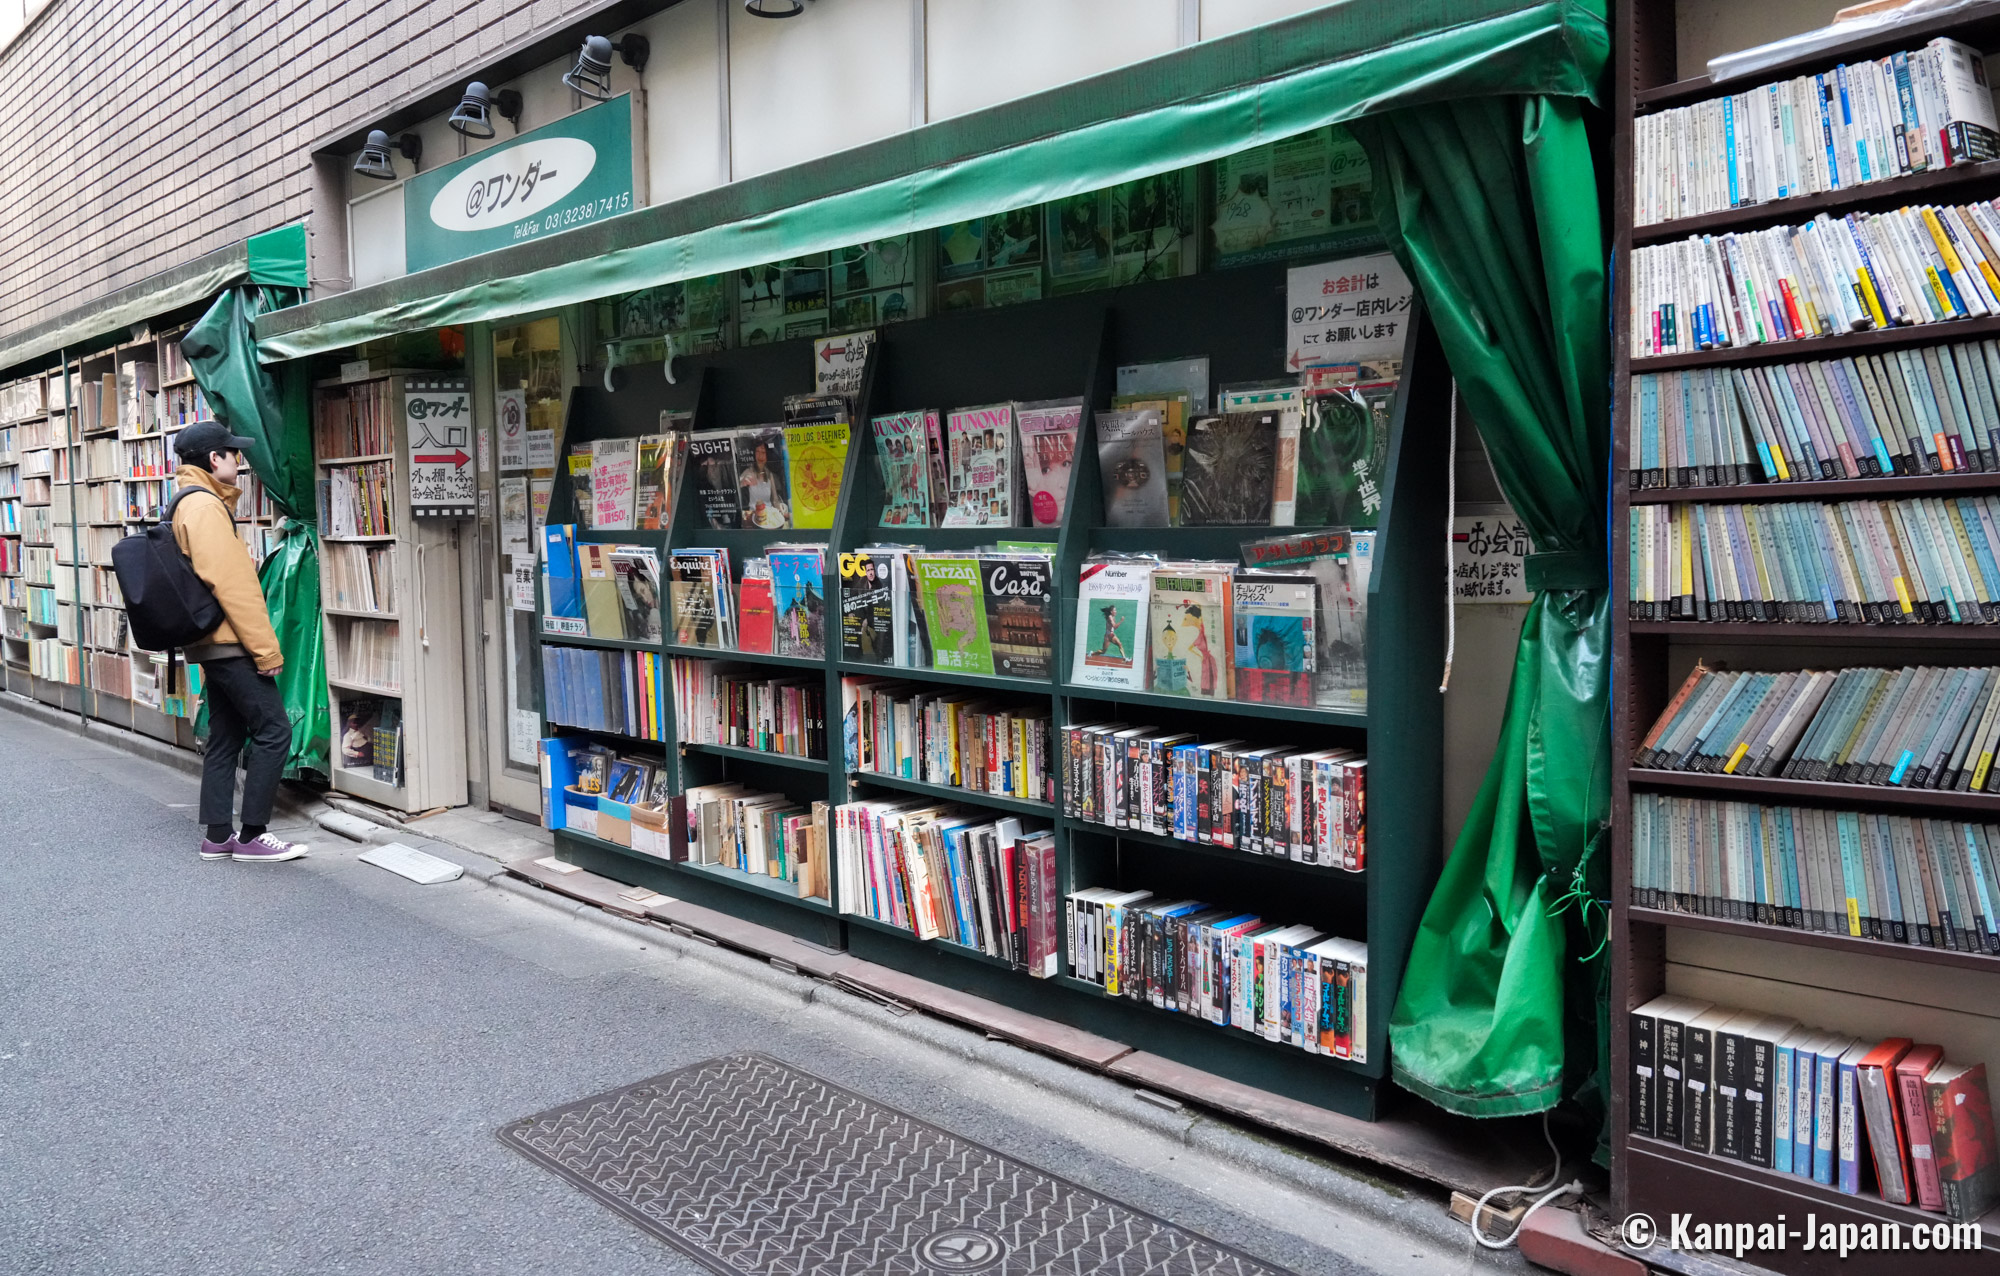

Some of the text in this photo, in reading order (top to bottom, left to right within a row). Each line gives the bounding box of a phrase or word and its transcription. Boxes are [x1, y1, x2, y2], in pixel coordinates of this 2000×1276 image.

[465, 160, 557, 218] @ワンダー
[513, 192, 629, 239] Tel&Fax 03(3238)7415
[1322, 273, 1379, 294] お会計は
[1292, 295, 1413, 323] @ワンダー店内レジ
[1303, 322, 1398, 345] にて お願いします
[407, 396, 469, 420] @ワンダー
[411, 423, 467, 449] 入口
[690, 440, 730, 455] SIGHT
[787, 433, 801, 443] TRIO
[817, 429, 846, 440] DELFINES
[411, 468, 474, 483] 外の棚の本の
[1352, 458, 1382, 516] 地下世界
[411, 484, 474, 500] お会計はこちら
[1252, 536, 1344, 560] アサヒグラフ
[670, 557, 712, 574] Esquire
[921, 564, 977, 580] Tarzan
[990, 566, 1043, 596] Casa
[1235, 584, 1274, 594] チェルノブイリ
[1235, 593, 1266, 602] クライシス
[560, 621, 584, 632] 映画チラシ
[1754, 1044, 1766, 1083] 国盗り物語
[1777, 1086, 1789, 1130] 菜の花の沖
[1905, 1079, 1922, 1117] 織田信長
[1799, 1091, 1811, 1135] 菜の花の沖
[1820, 1097, 1833, 1141] 菜の花の沖
[1841, 1106, 1854, 1151] 菜の花の沖
